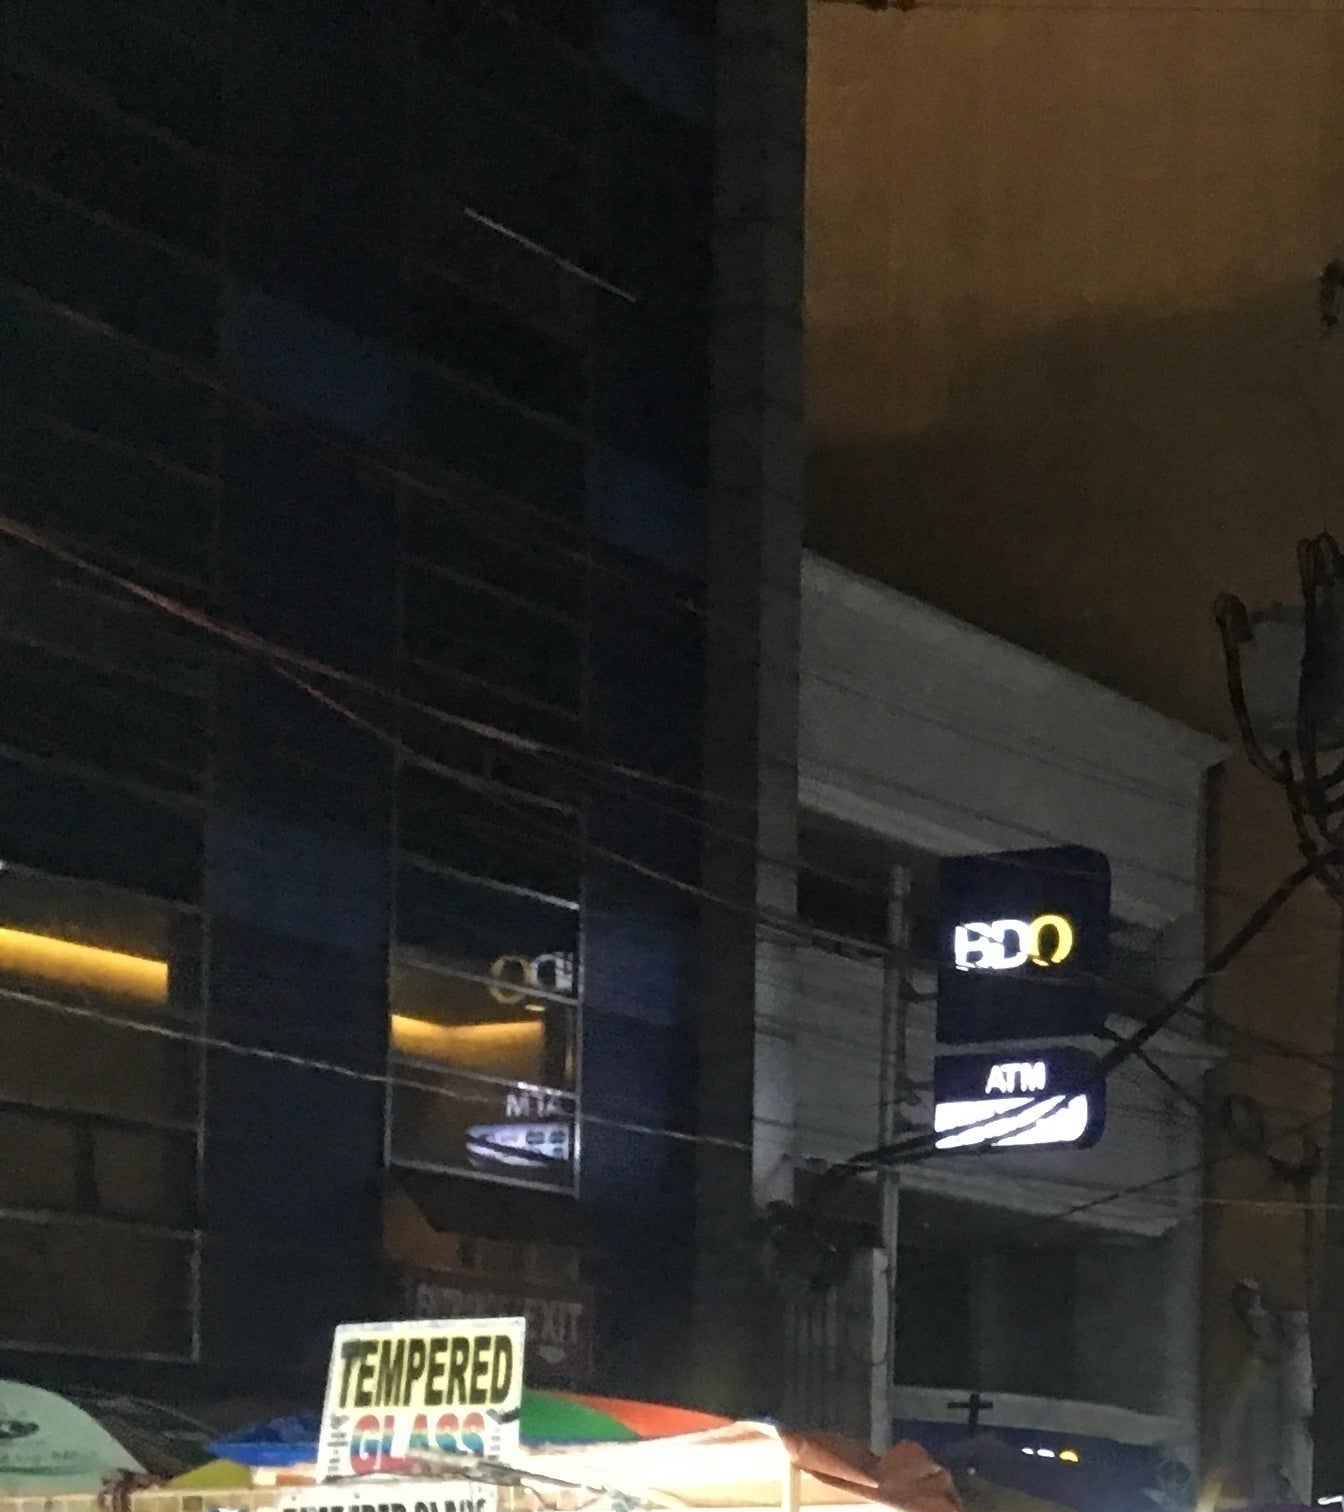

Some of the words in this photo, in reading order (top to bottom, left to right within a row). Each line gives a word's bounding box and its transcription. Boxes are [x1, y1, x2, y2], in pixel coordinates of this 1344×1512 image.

[953, 913, 1074, 971] BDO
[984, 1062, 1047, 1094] ATM
[338, 1334, 513, 1408] TEMPERED
[350, 1412, 486, 1475] GLASS
